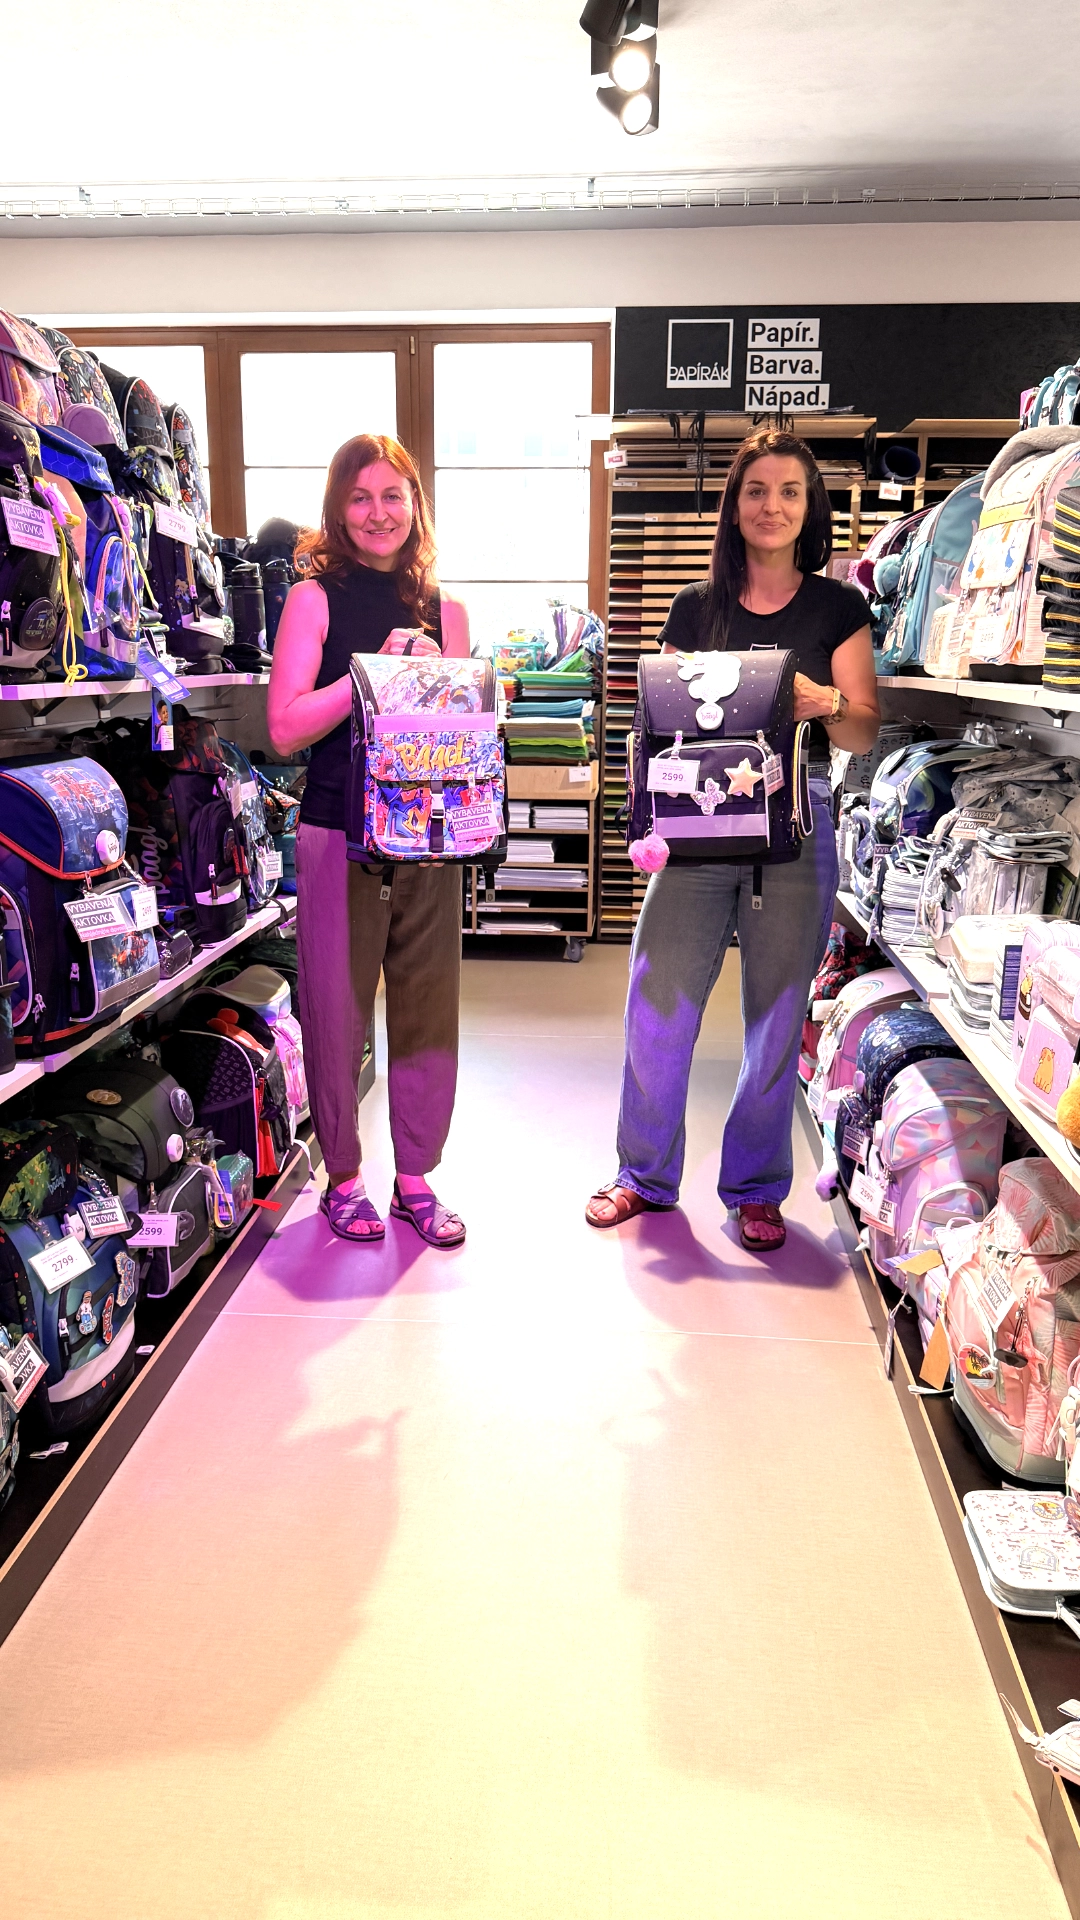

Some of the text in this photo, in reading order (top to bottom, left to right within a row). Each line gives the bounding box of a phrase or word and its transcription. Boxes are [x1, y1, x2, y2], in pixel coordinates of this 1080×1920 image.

[751, 321, 814, 347] Papír.
[669, 362, 729, 381] PAPÍRÁK
[749, 354, 820, 375] Barva.
[748, 385, 826, 411] Nápad.
[395, 736, 471, 772] BAAGL
[454, 817, 489, 831] AKTOVKA
[75, 912, 116, 928] AKTOVKA
[88, 1214, 119, 1227] AKTOVKA
[11, 1343, 30, 1370] AVENÁ
[19, 1361, 35, 1384] OVKA
